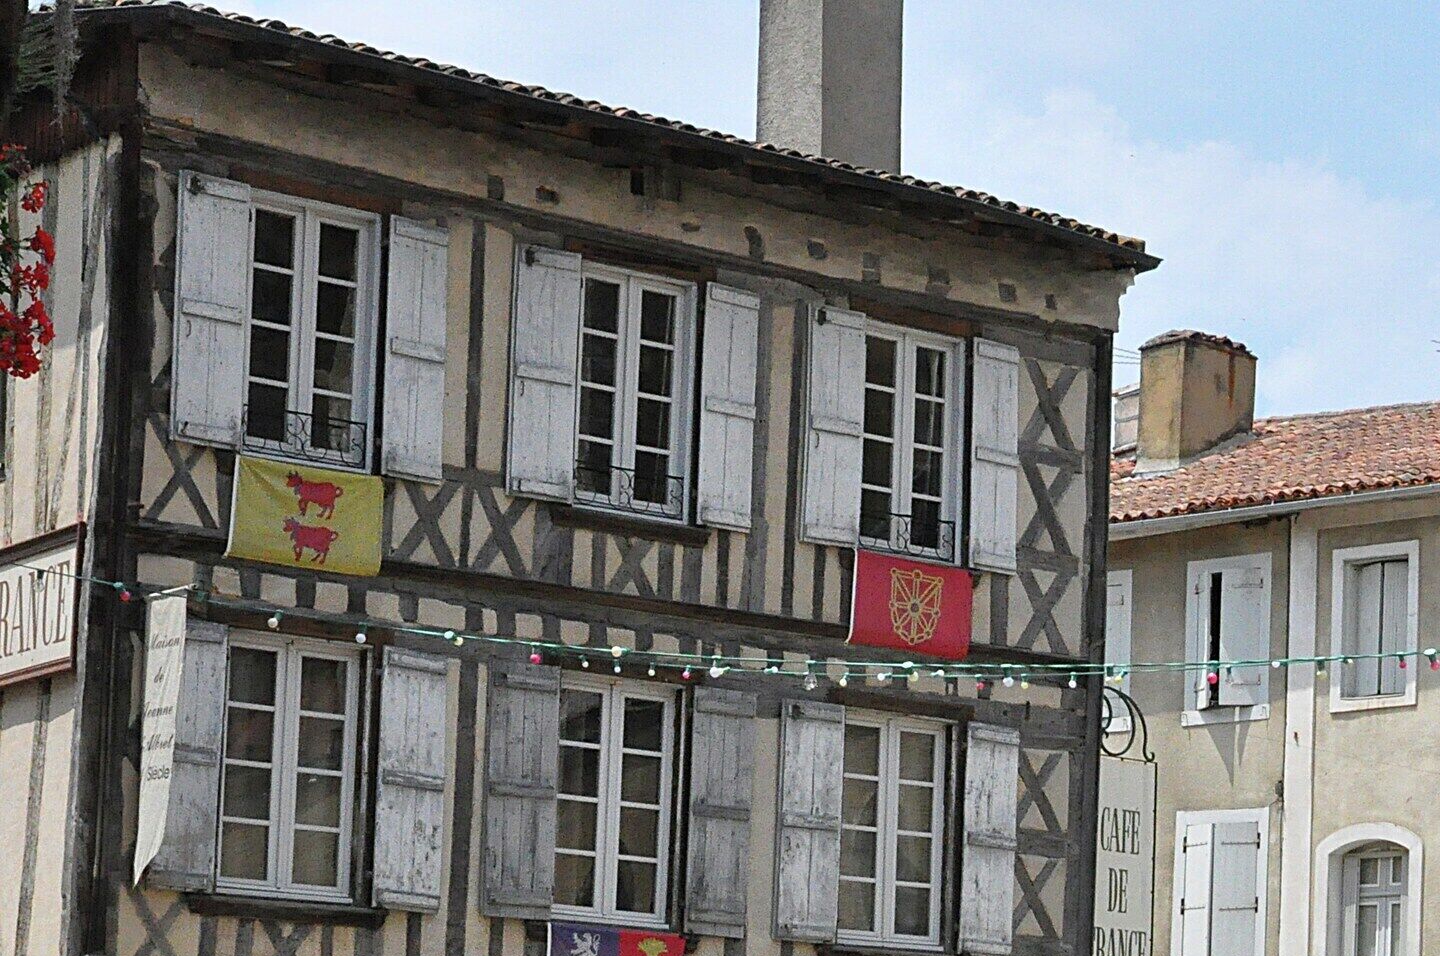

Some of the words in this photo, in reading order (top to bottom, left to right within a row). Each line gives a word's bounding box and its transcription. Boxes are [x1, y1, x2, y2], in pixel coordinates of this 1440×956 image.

[0, 561, 70, 657] RANCE
[1100, 807, 1140, 855] CAFÉ
[1107, 867, 1128, 914] DE
